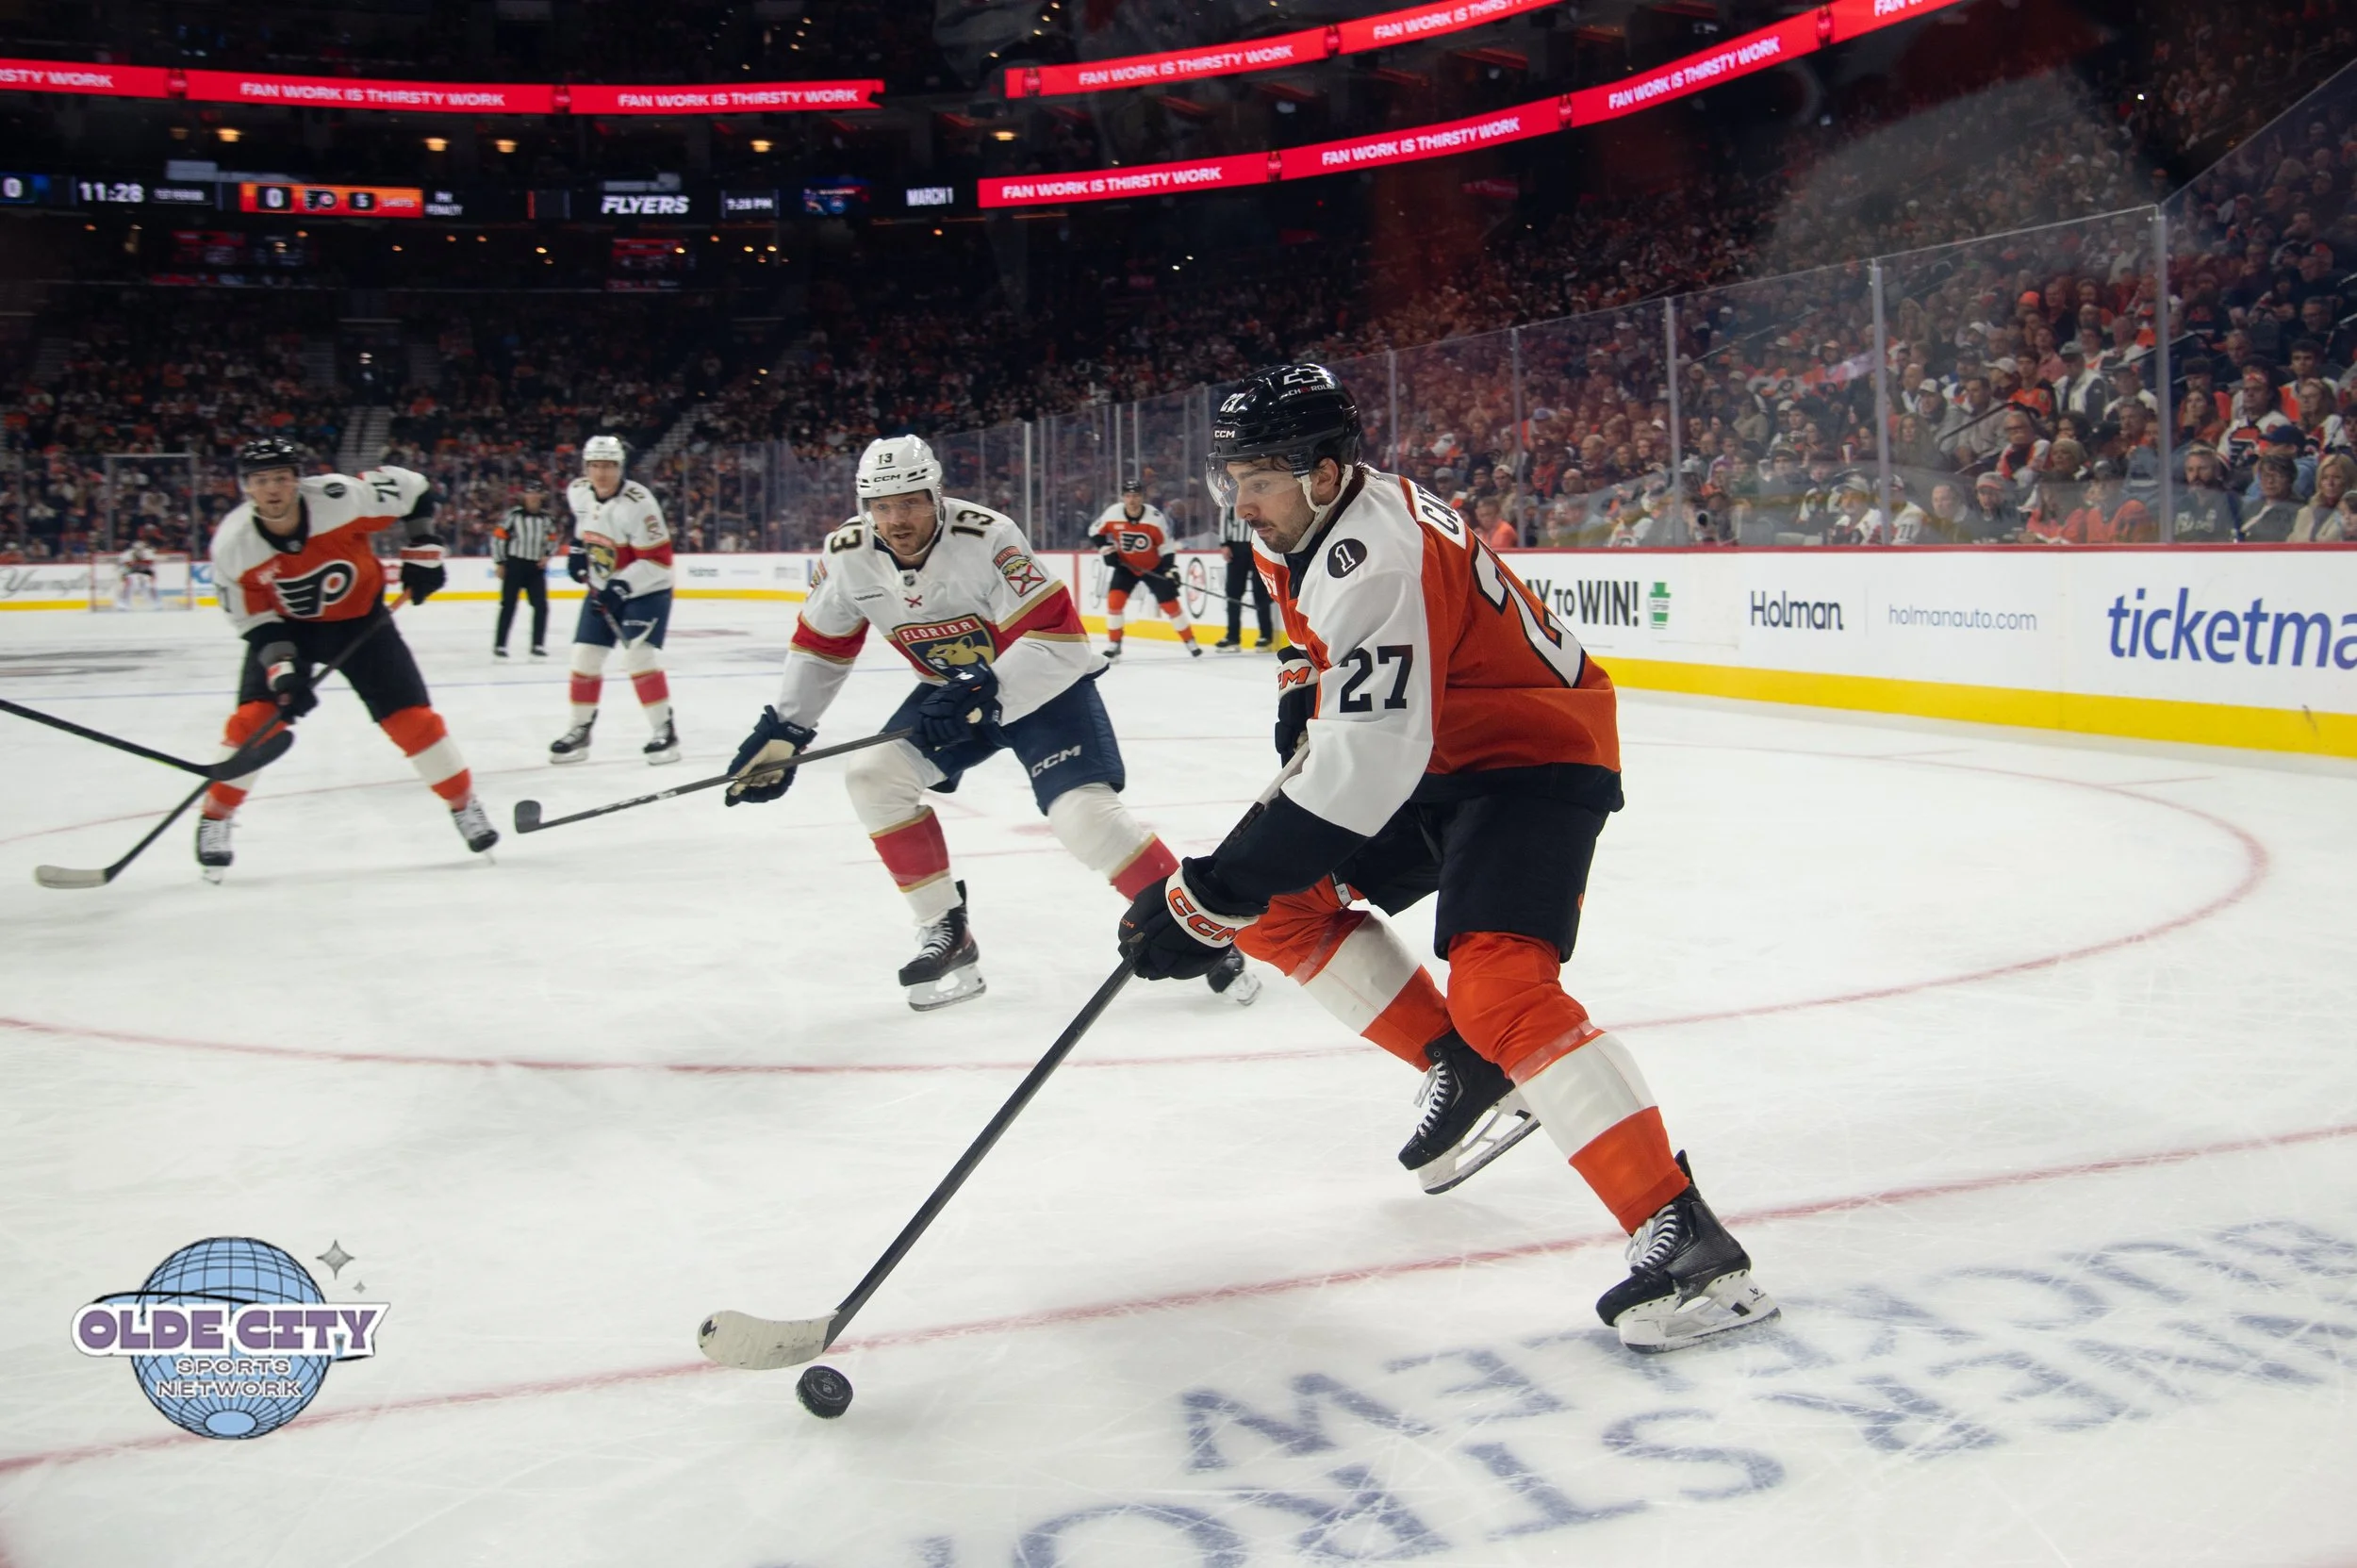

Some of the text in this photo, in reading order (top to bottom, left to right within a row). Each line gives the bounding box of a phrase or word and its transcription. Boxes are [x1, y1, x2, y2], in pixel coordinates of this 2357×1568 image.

[1373, 0, 1524, 40] FAN WORK IS THIRS
[46, 71, 114, 88] WORK
[1079, 45, 1294, 86] FAN WORK IS THIRSTY WORK
[1608, 35, 1781, 109] FAN WORK IS THIRSTY WORK
[240, 82, 506, 107] FAN WORK IS THIRSTY WORK
[618, 90, 858, 107] FAN WORK IS THIRSTY WORK
[1322, 117, 1520, 166] FAN WORK IS THIRSTY WORK
[3, 177, 23, 198] 0
[906, 188, 947, 206] MARCH
[1001, 167, 1222, 199] FAN WORK IS THIRSTY WORK
[266, 189, 283, 207] 0
[601, 195, 690, 214] FLYERS
[1213, 429, 1236, 438] CCM
[878, 453, 893, 465] 13
[873, 473, 901, 483] CCM
[949, 509, 995, 539] 13
[1333, 544, 1356, 572] 1
[1470, 533, 1587, 688] 2
[1555, 589, 1575, 617] TO
[1577, 580, 1640, 627] WIN!
[1751, 590, 1844, 630] Holman
[1887, 603, 2037, 631] holmanauto.com
[901, 621, 974, 641] FLORIDA
[2107, 586, 2357, 669] ticketma
[1339, 644, 1414, 714] 27
[1030, 745, 1081, 778] CCM
